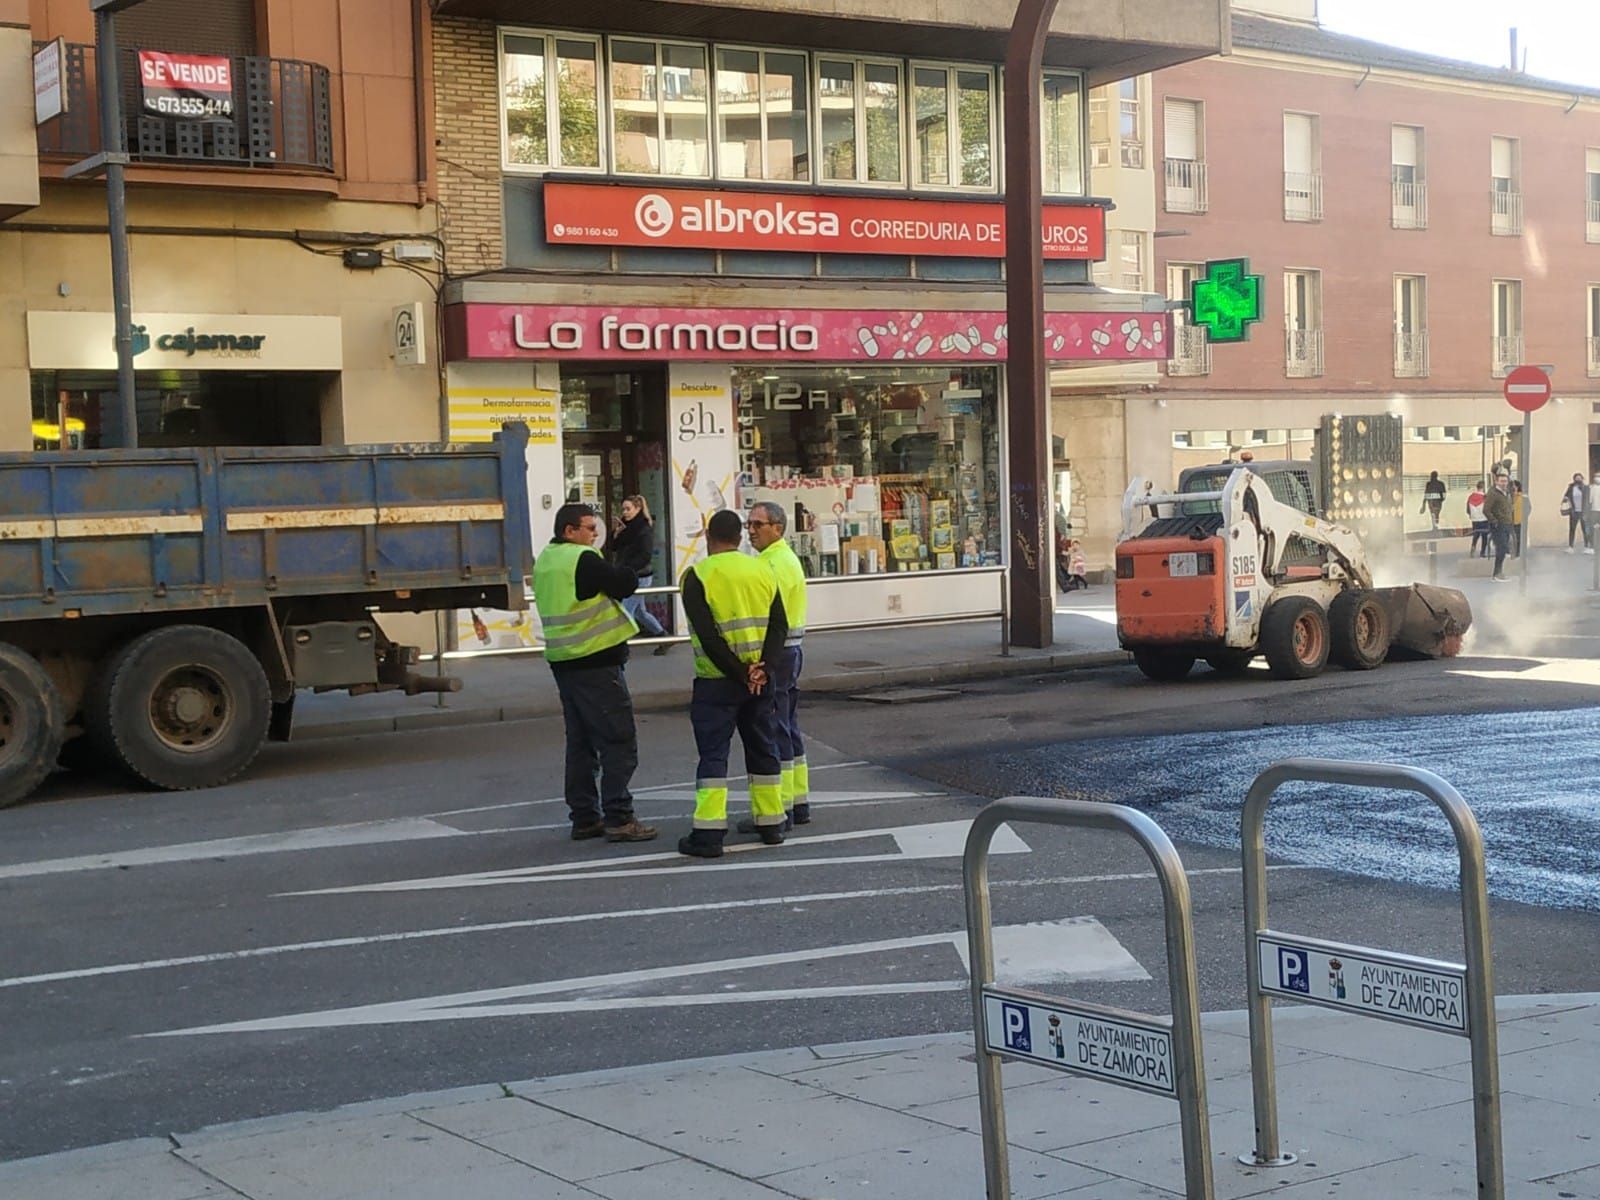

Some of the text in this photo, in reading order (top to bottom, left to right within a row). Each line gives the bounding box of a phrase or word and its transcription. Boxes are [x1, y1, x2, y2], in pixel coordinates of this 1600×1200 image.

[143, 60, 228, 85] SE VENDE
[566, 226, 583, 237] 980
[584, 226, 601, 237] 160
[680, 199, 840, 237] albroksa
[850, 218, 1088, 244] CORREDURIA DE UROS
[156, 327, 266, 357] cajamar
[514, 313, 820, 351] La farmacia
[681, 381, 718, 391] Descubre
[483, 397, 551, 408] Dermofarmacia
[538, 415, 552, 423] tus
[1232, 556, 1256, 575] S185
[1361, 965, 1459, 999] AYUNTAMIENTO
[1361, 983, 1460, 1023] DE ZAMORA
[1077, 1021, 1168, 1057] AYUNTAMIENTO
[1077, 1041, 1169, 1084] DE ZAMORA
